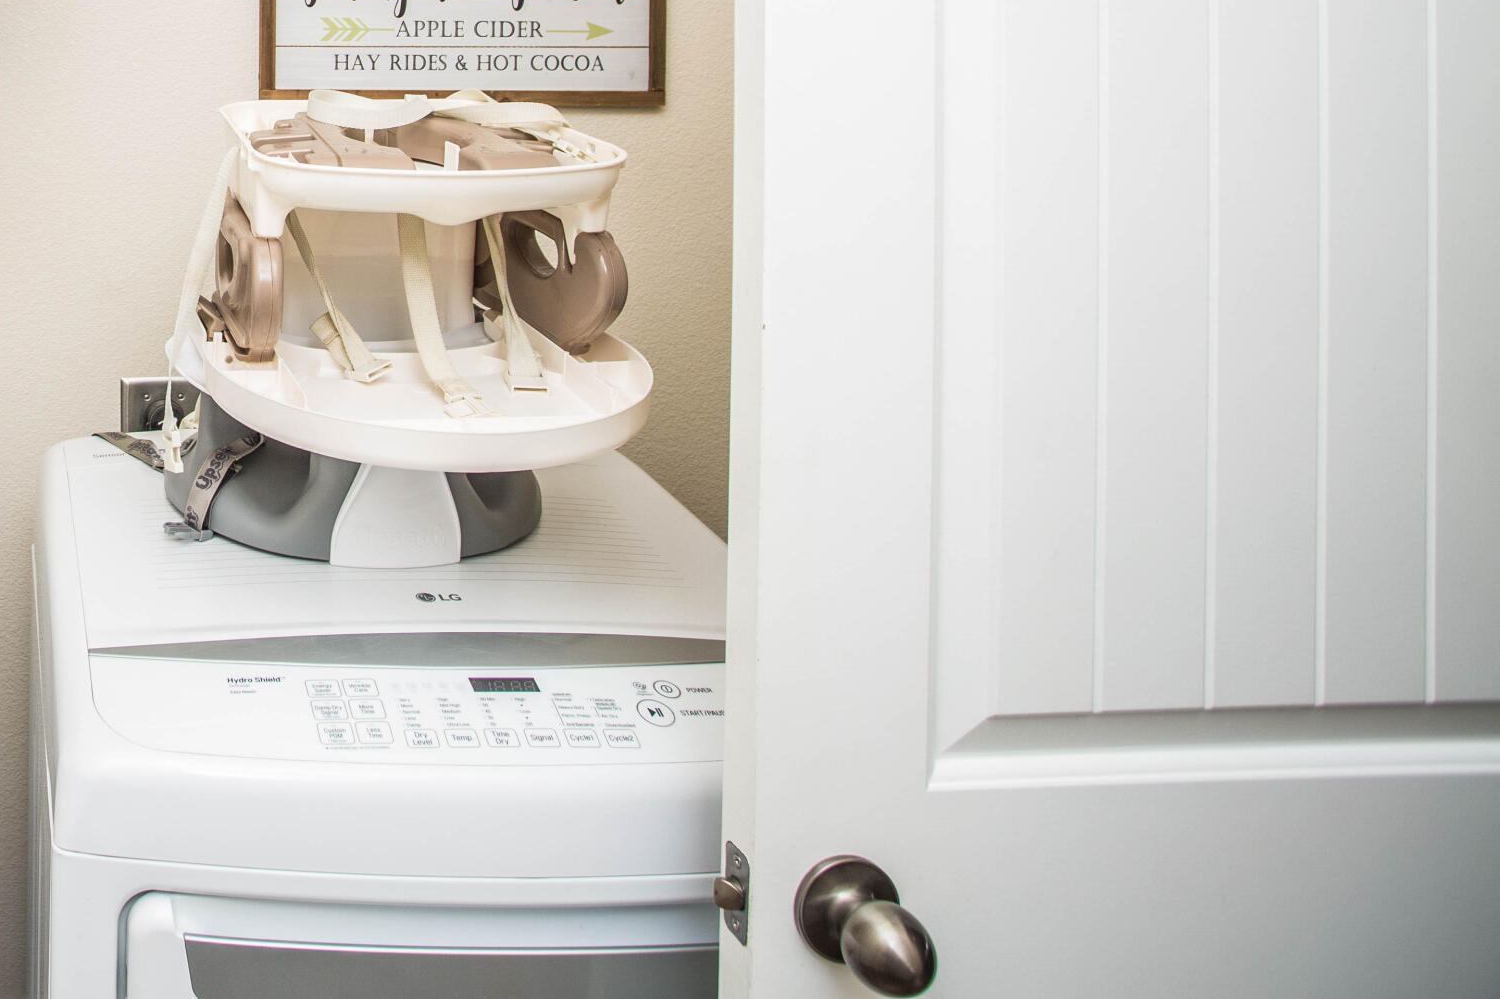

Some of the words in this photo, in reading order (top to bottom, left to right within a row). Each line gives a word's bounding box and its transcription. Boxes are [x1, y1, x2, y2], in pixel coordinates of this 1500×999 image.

[396, 20, 464, 38] APPLE
[474, 20, 543, 38] CIDER
[333, 54, 380, 71] HAY
[389, 54, 447, 71] RIDES
[455, 54, 468, 71] &
[477, 54, 522, 71] HOT
[530, 54, 604, 72] COCOA
[438, 593, 462, 601] LG
[413, 731, 428, 739] Dry
[452, 734, 473, 742] Temp
[530, 734, 553, 742] Signal
[570, 734, 594, 742] Cycle1
[608, 734, 634, 742] Cycle2
